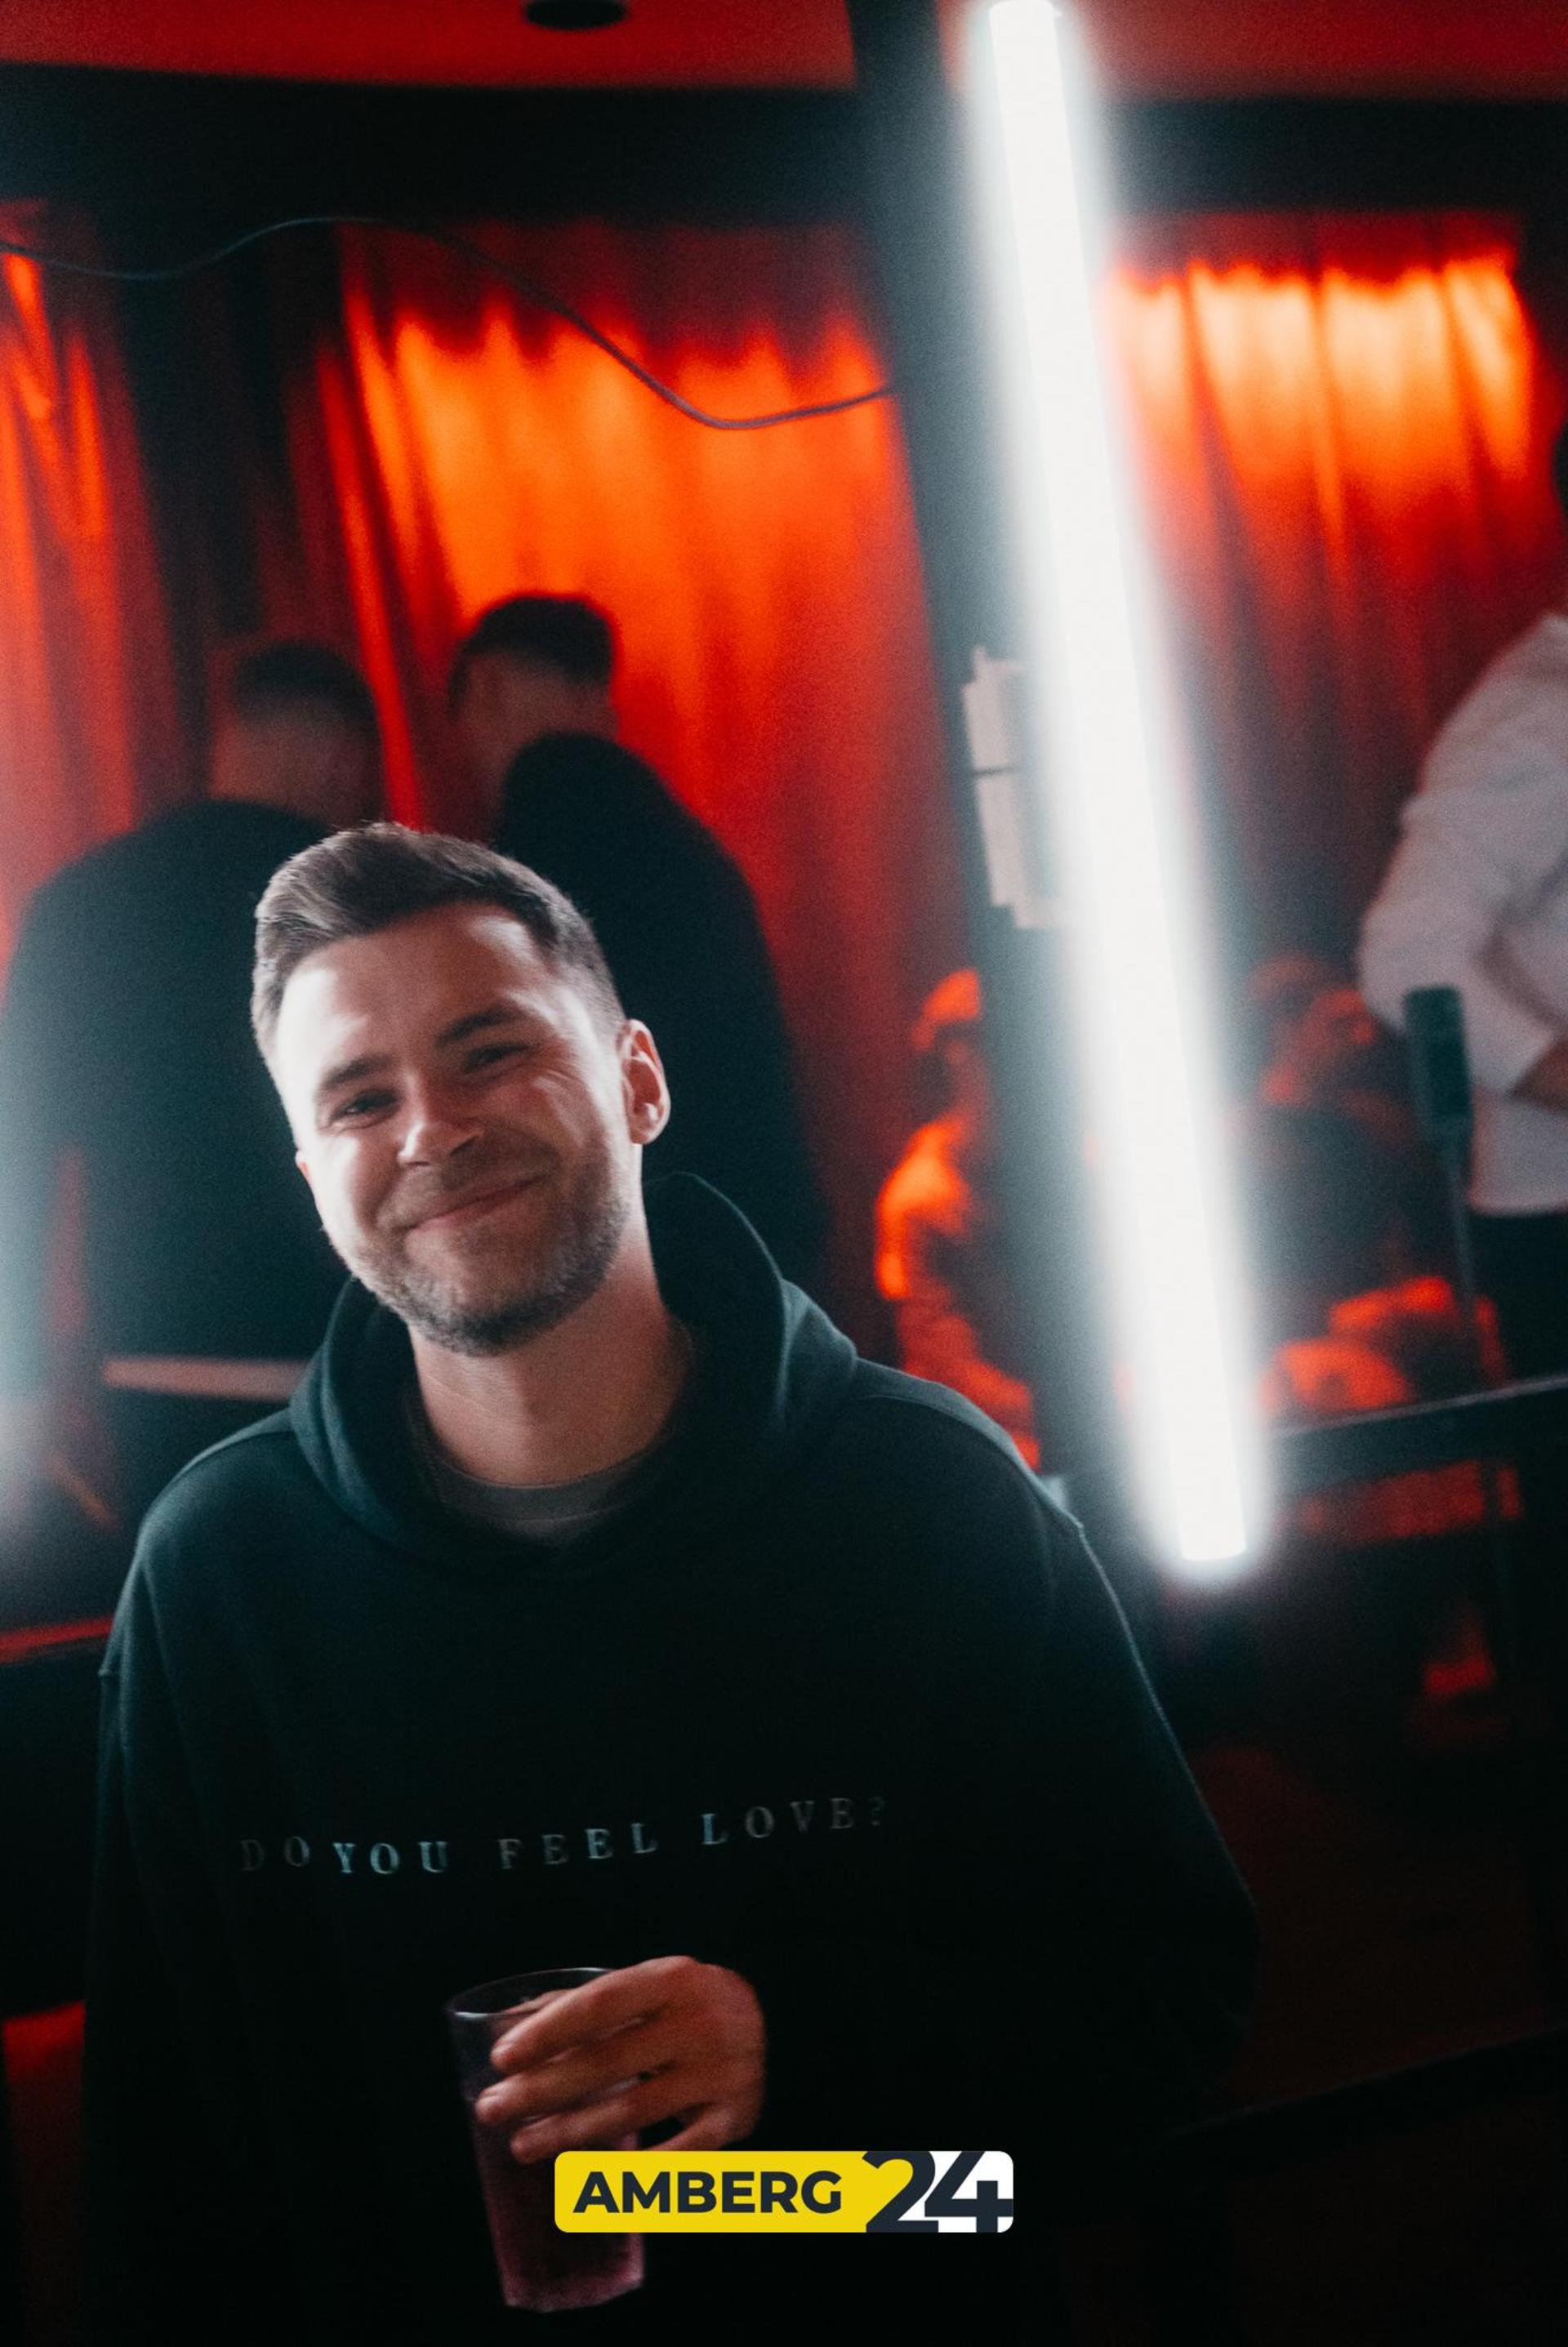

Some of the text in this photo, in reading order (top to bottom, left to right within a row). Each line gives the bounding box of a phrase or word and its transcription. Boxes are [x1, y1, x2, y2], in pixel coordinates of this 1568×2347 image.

[239, 1796, 886, 1875] DO YOU FEEL LOVE?
